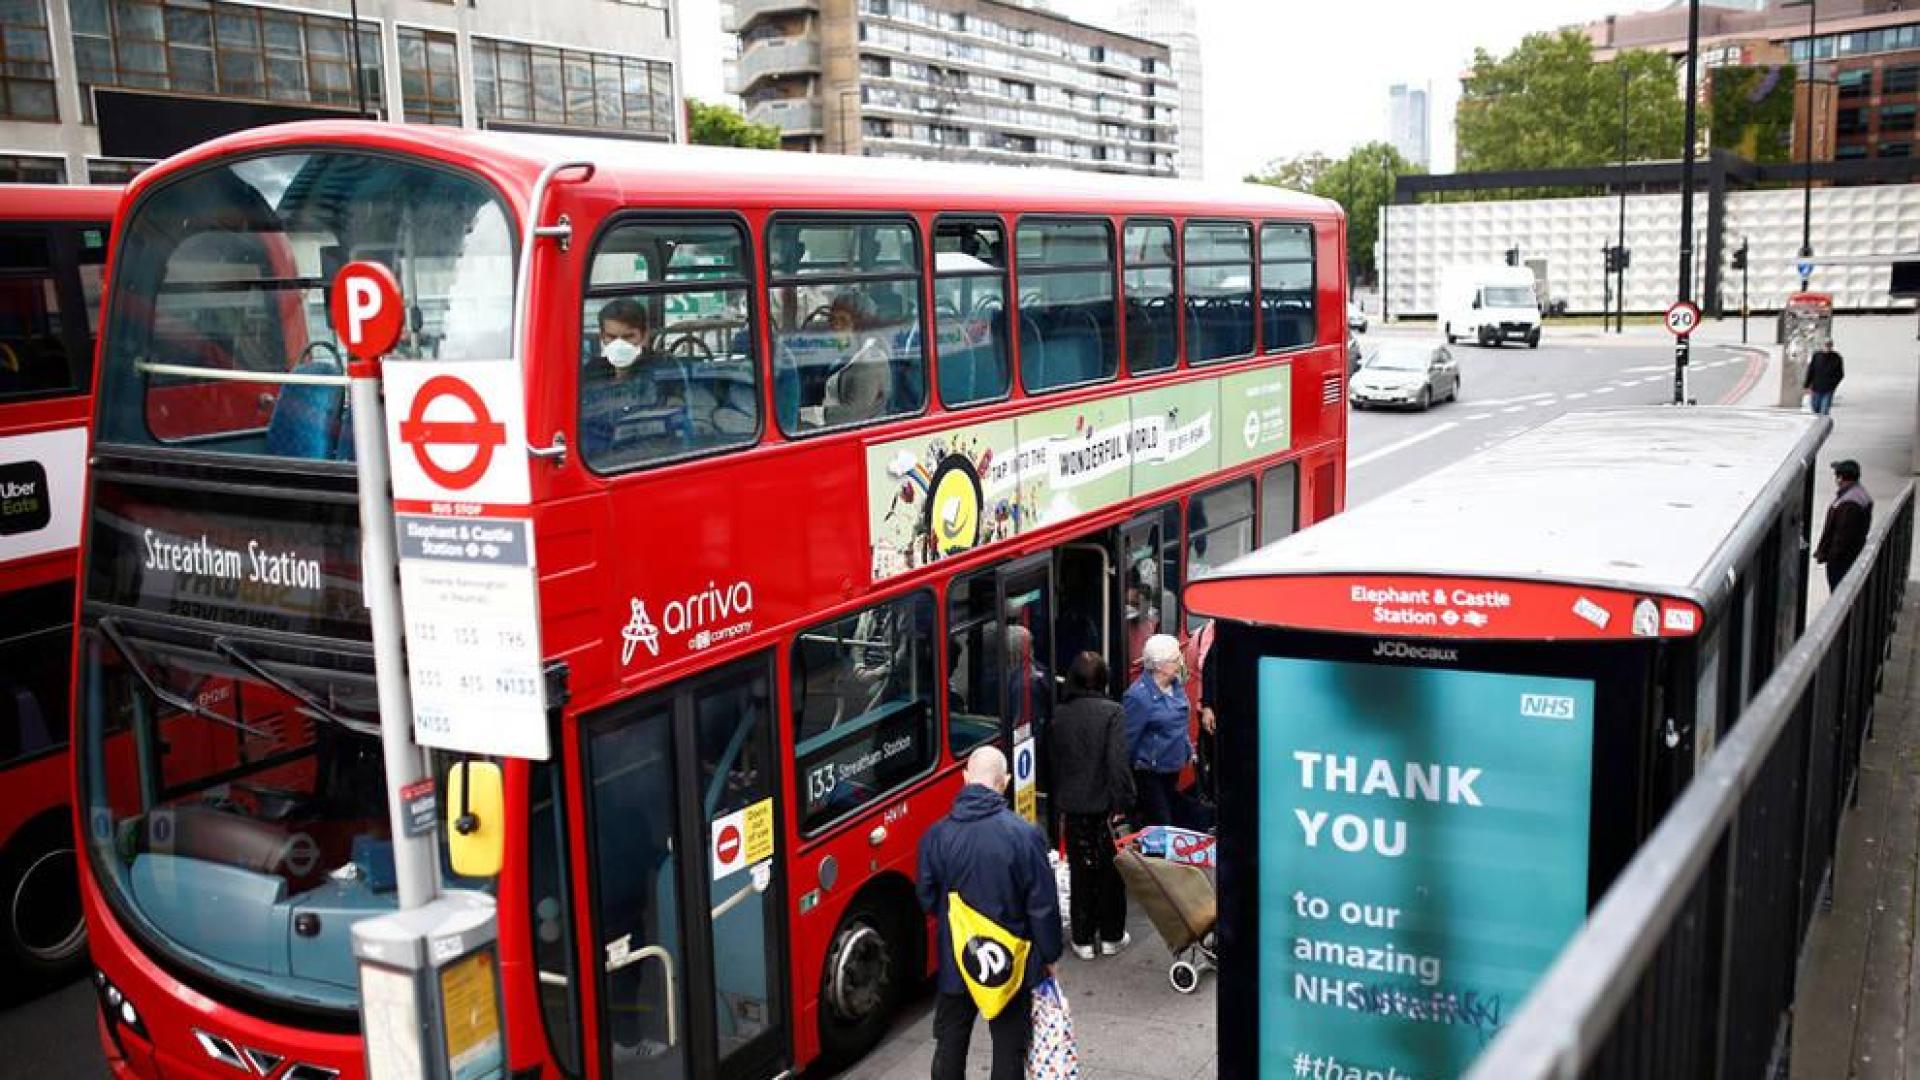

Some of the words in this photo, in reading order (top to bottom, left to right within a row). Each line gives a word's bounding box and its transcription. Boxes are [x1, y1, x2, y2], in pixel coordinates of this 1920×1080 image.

[346, 277, 382, 344] P
[1671, 312, 1692, 327] 20
[1059, 436, 1122, 476] WONDERFUL
[1126, 426, 1158, 453] WORLD
[0, 481, 36, 499] Uber
[407, 521, 457, 541] Elephant
[460, 525, 470, 540] &
[472, 525, 513, 542] Castle
[422, 539, 463, 556] Station
[145, 528, 241, 579] Streatham
[248, 540, 321, 590] Station
[663, 580, 753, 635] arriva
[1351, 585, 1429, 606] Elephant
[1433, 589, 1447, 605] &
[1452, 589, 1511, 607] Castle
[1373, 606, 1436, 625] Station
[1373, 641, 1458, 661] JCDecaux
[1523, 696, 1571, 717] NHS
[808, 763, 836, 802] 133
[839, 749, 881, 781] Streatham
[883, 735, 911, 759] Station
[1294, 750, 1483, 807] THANK
[1294, 808, 1407, 858] YOU
[1294, 890, 1329, 920] to
[1339, 902, 1401, 929] our
[1294, 937, 1441, 986] amazing
[1294, 973, 1365, 1010] NHS
